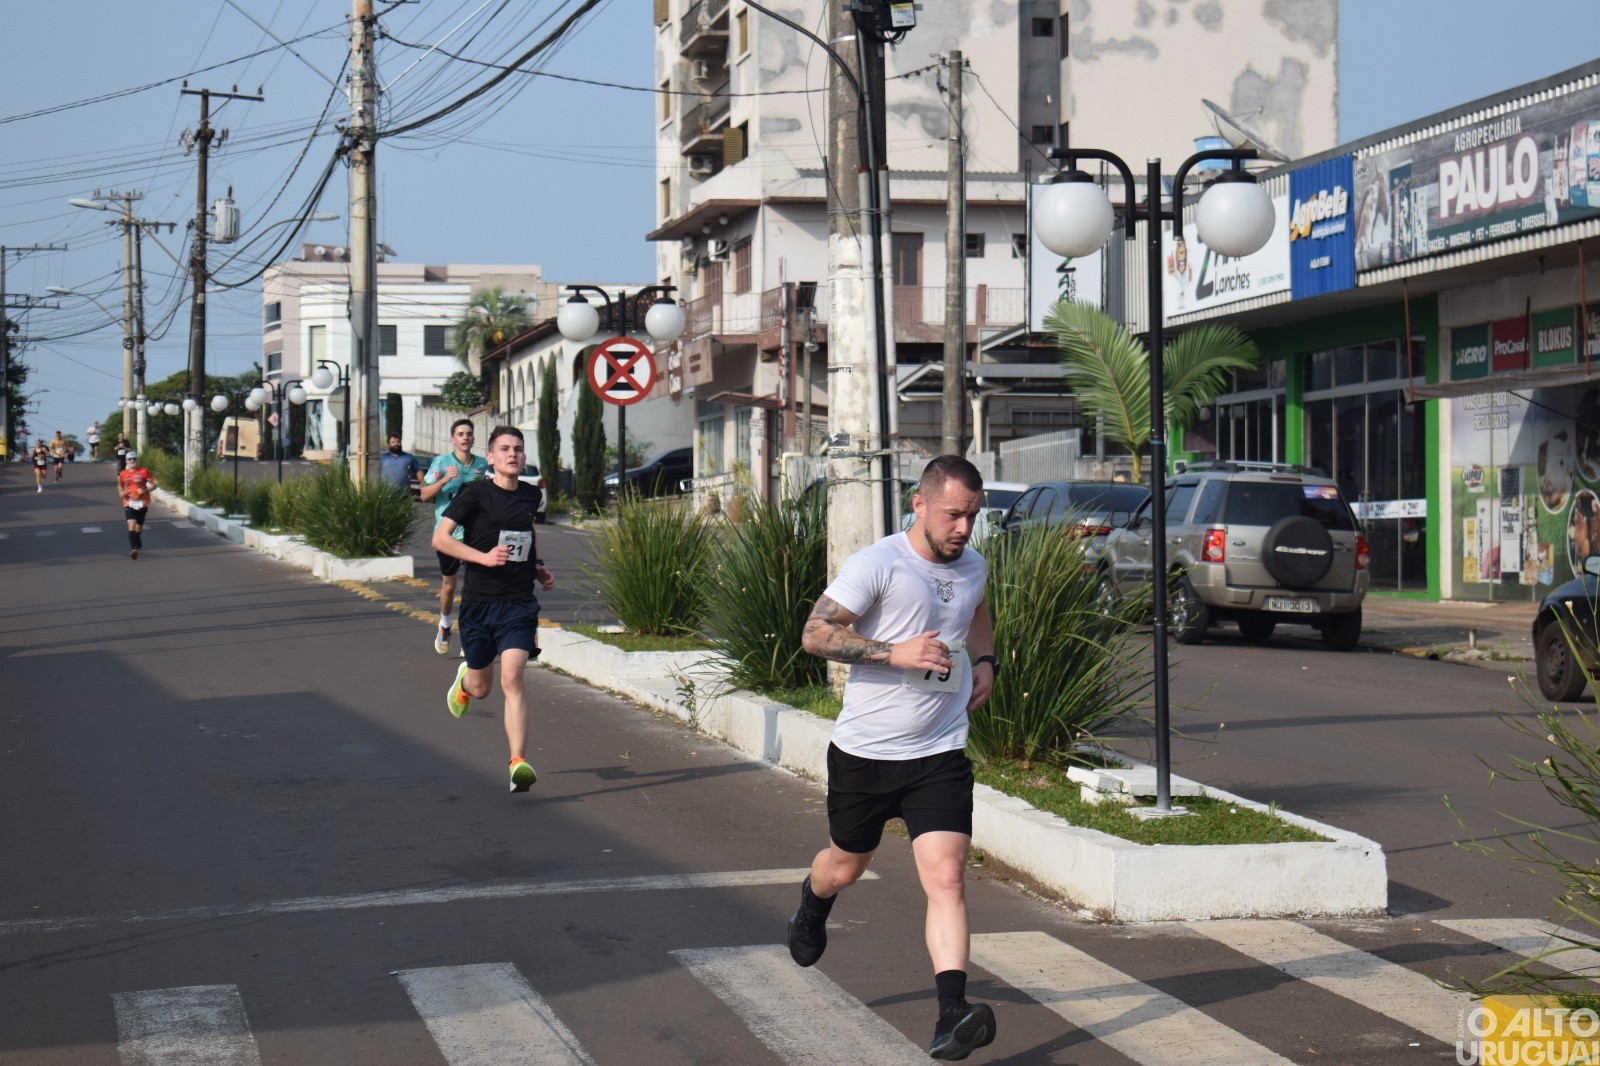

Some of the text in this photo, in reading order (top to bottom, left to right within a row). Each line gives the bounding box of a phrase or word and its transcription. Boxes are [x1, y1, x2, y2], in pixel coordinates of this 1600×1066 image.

[1454, 115, 1521, 153] AGROPECUÁRIA
[1439, 136, 1539, 219] PAULO
[1290, 186, 1348, 235] AgroBella
[1449, 230, 1471, 247] MINERAIS
[1475, 227, 1484, 241] PET
[1489, 220, 1517, 237] FERRAGENS
[1521, 212, 1546, 231] DIVERSOS
[1214, 267, 1250, 297] Lanches
[1455, 345, 1487, 365] AGRO
[1538, 326, 1572, 352] BLOKUS
[507, 544, 523, 556] 21
